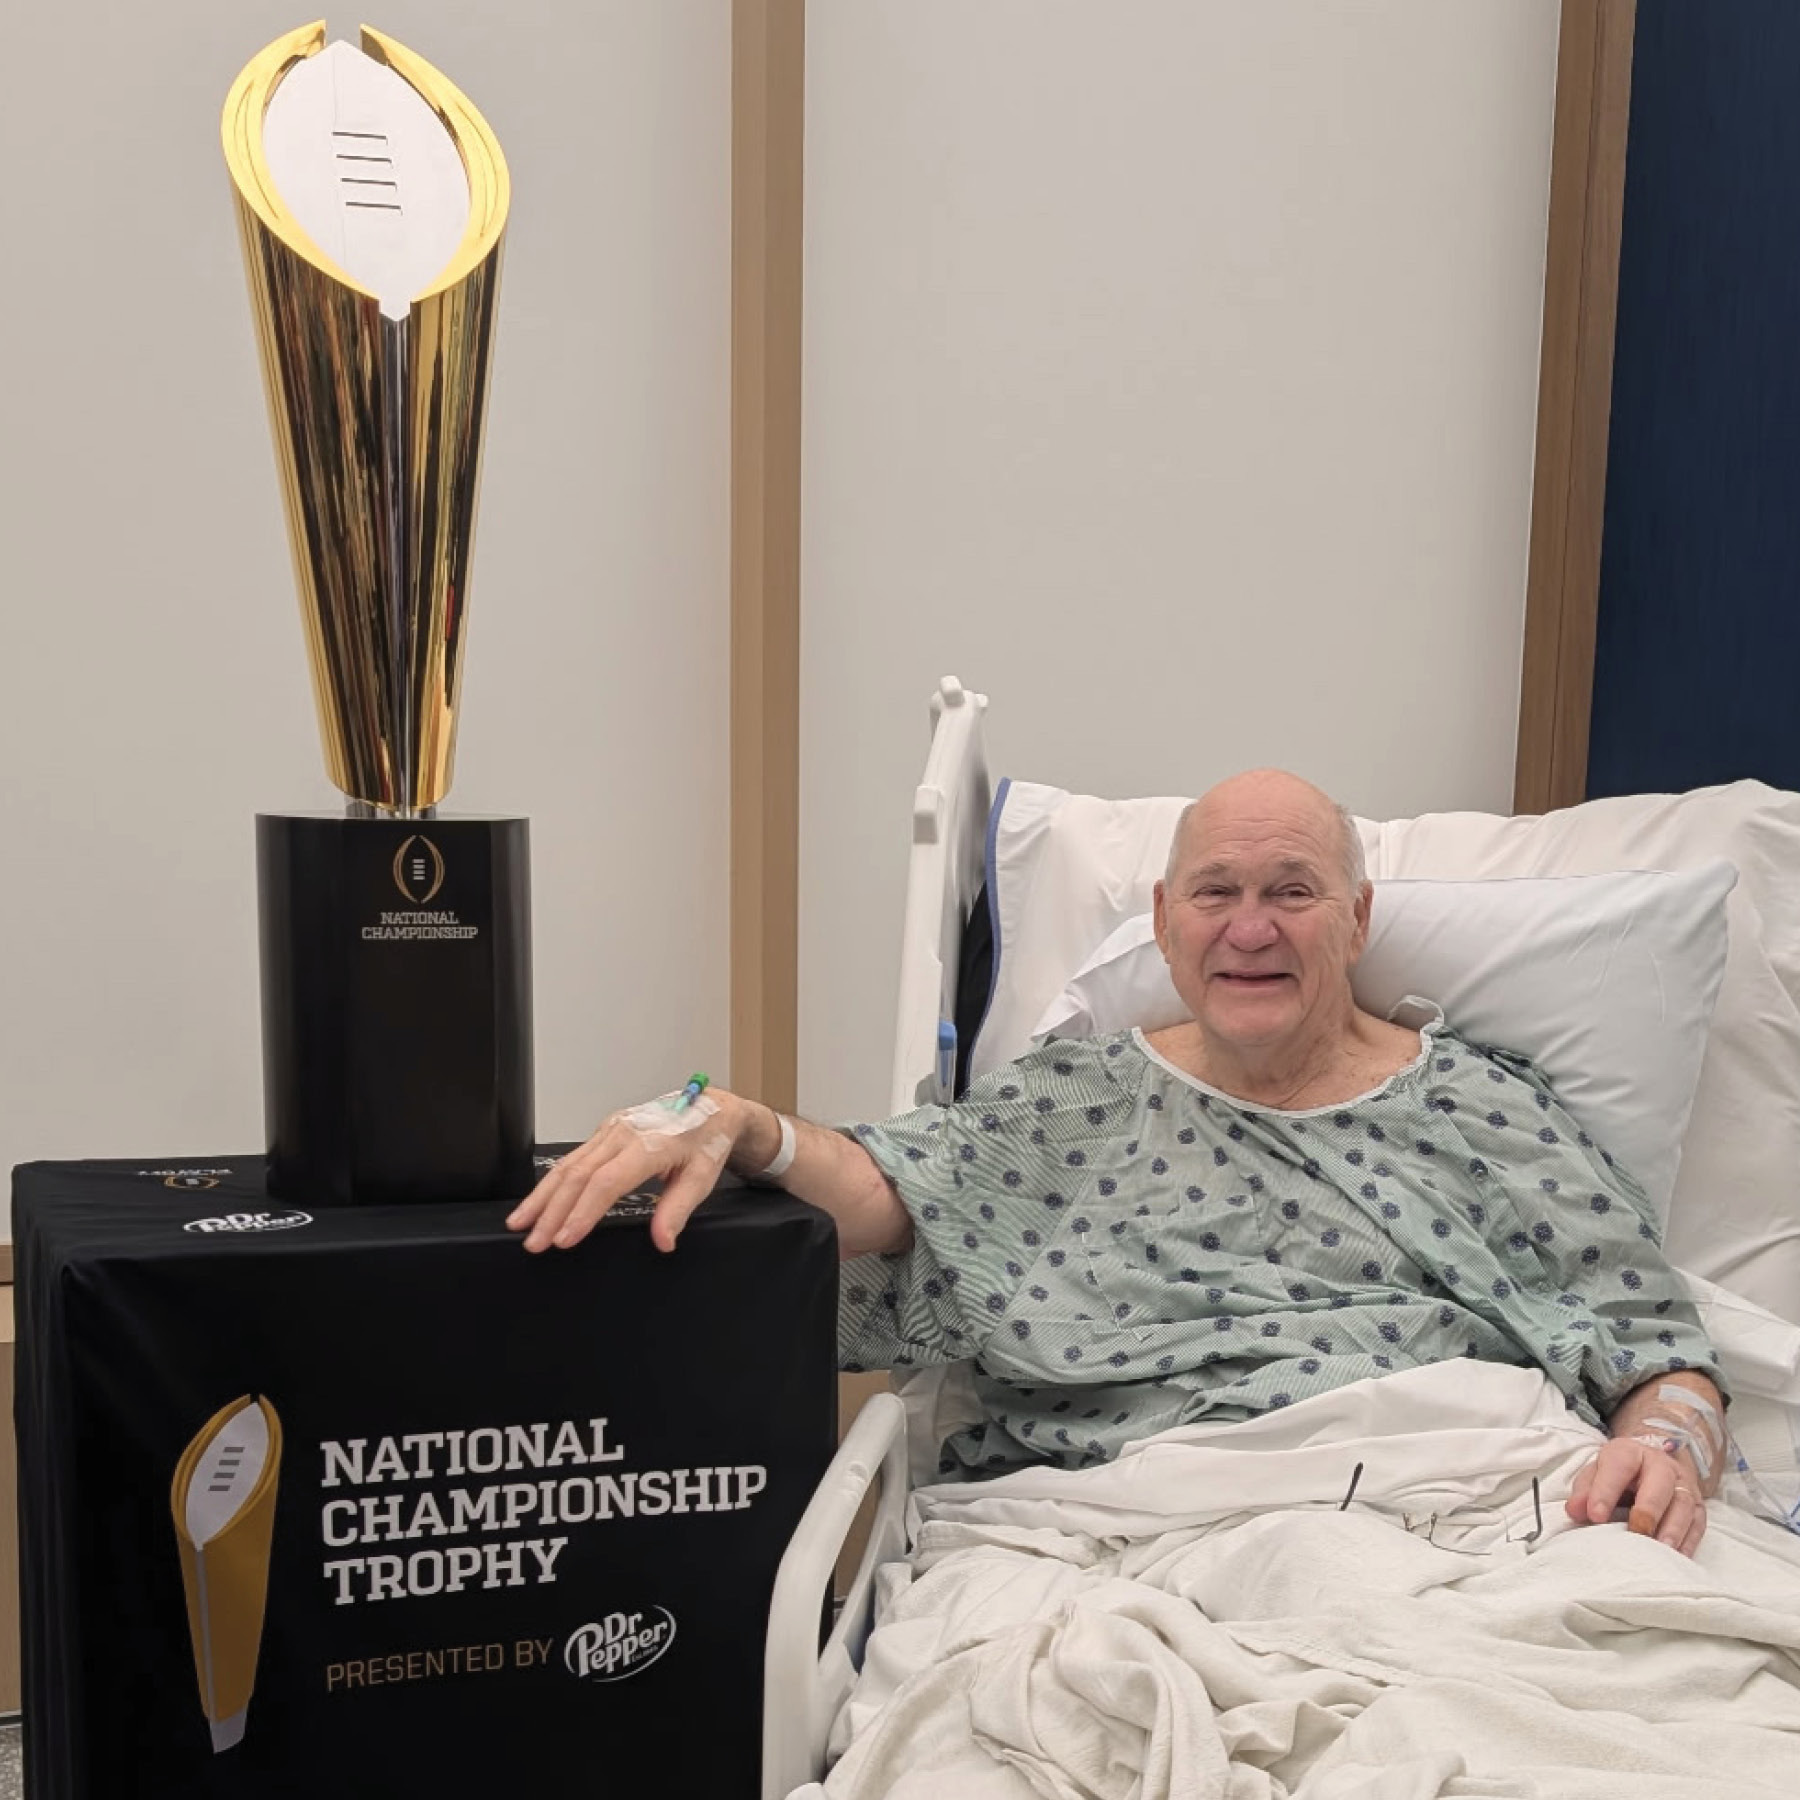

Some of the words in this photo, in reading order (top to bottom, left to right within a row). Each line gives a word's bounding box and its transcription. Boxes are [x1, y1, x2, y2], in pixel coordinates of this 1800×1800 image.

[361, 926, 479, 939] CHAMPIONSHIP
[380, 911, 460, 924] NATIONAL
[320, 1417, 625, 1488] NATIONAL
[321, 1464, 768, 1547] CHAMPIONSHIP
[323, 1536, 569, 1605] TROPHY
[577, 1621, 668, 1677] Pepper
[603, 1612, 643, 1645] Dr
[326, 1643, 504, 1692] PRESENTED
[515, 1637, 555, 1667] BY
